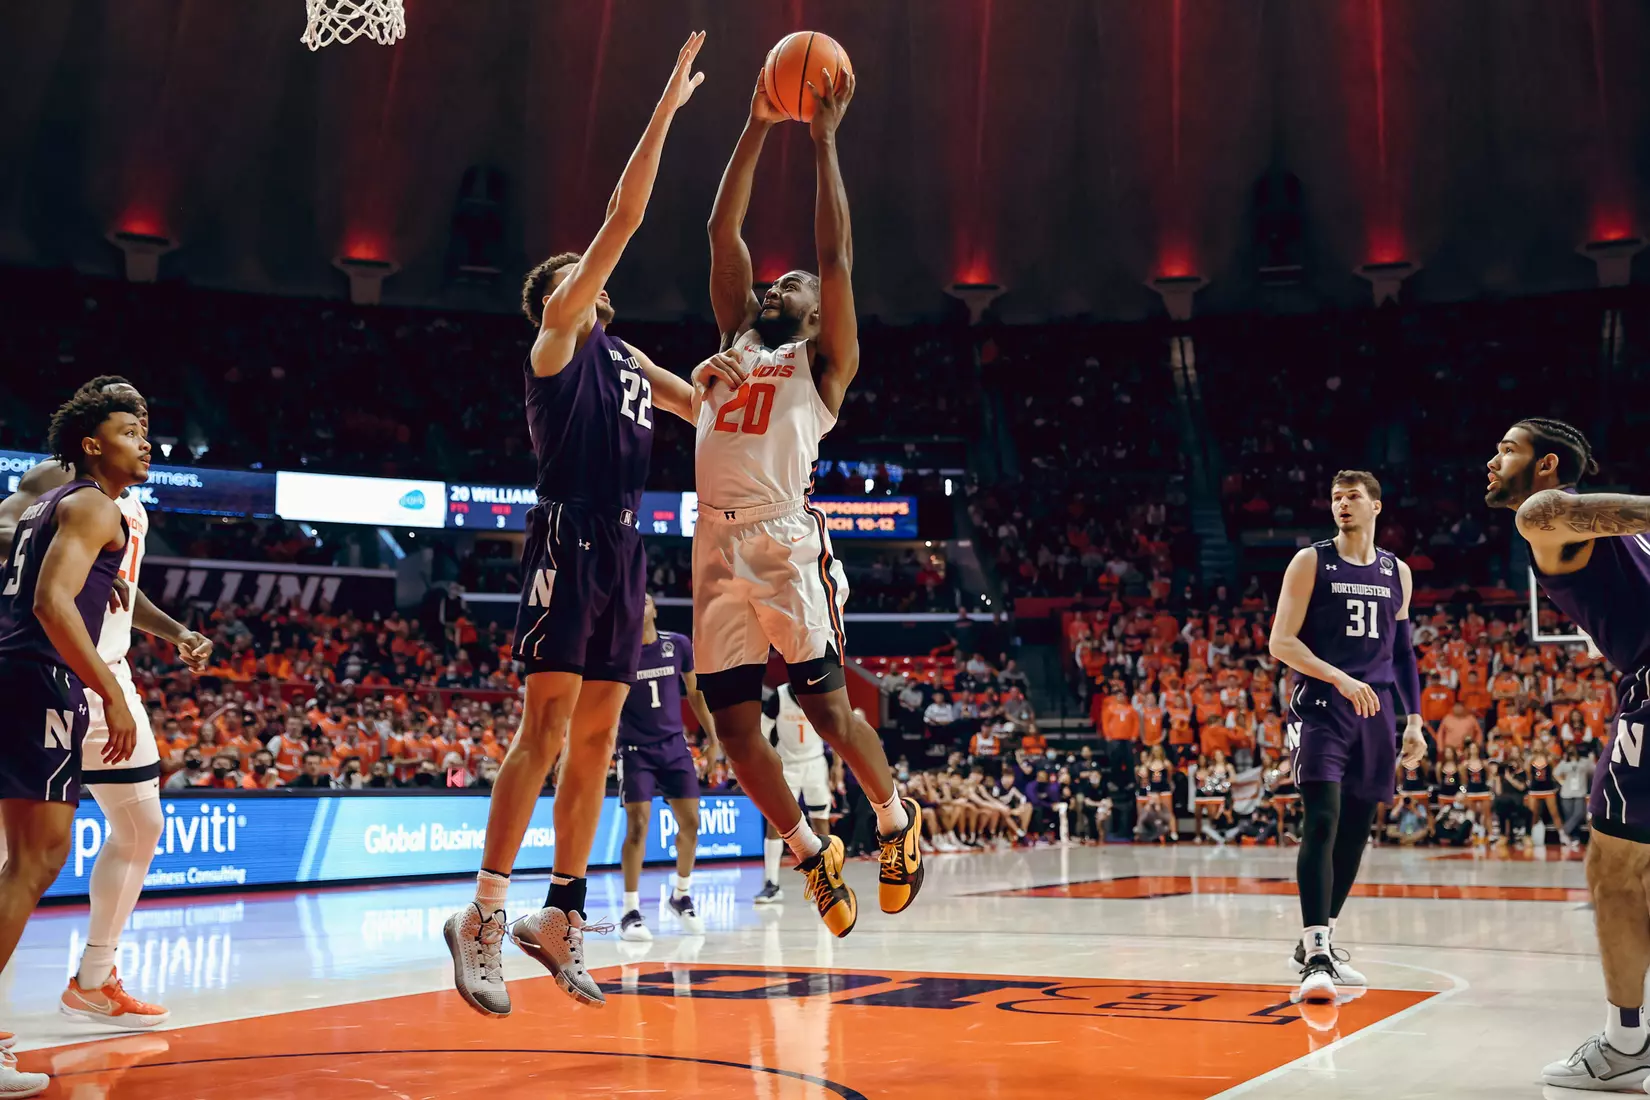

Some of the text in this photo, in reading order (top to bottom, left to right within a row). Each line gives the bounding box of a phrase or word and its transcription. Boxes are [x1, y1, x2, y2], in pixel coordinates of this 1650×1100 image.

[620, 369, 652, 430] 22
[714, 382, 776, 435] 20
[450, 485, 471, 502] 20
[3, 528, 33, 596] 5
[118, 535, 139, 583] 1
[528, 568, 557, 608] N
[1331, 582, 1391, 598] NORTHWESTERN
[1346, 600, 1379, 639] 31
[648, 680, 661, 708] 1
[44, 708, 74, 751] N
[797, 724, 804, 744] 1
[1612, 719, 1644, 767] N
[75, 803, 236, 877] piviti
[364, 822, 426, 853] Global
